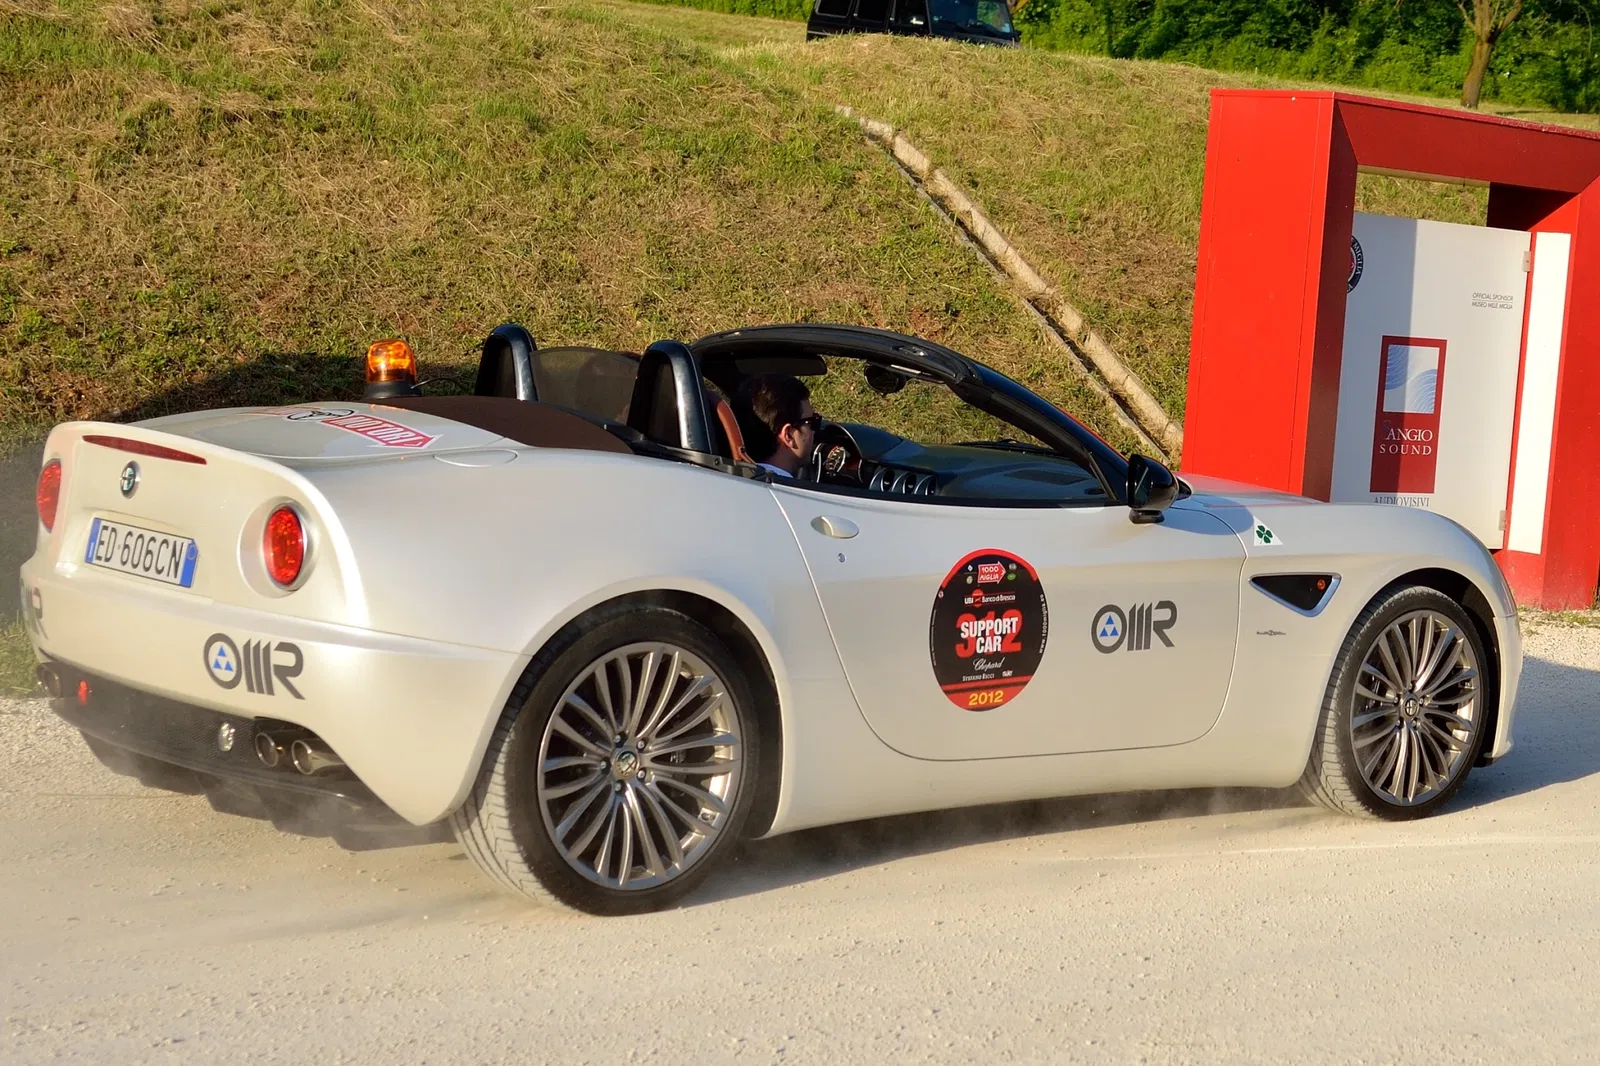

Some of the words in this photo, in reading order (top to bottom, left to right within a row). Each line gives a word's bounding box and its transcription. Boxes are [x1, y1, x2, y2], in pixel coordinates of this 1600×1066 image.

[1352, 242, 1363, 275] MIGLIA
[329, 416, 424, 444] MOTORI
[1379, 443, 1432, 456] SOUND
[1373, 496, 1430, 507] AUDIOVISIVI
[979, 573, 999, 581] MIGLIA
[981, 566, 999, 574] 1000
[964, 597, 974, 605] UBI
[960, 616, 1019, 639] SUPPORT
[975, 635, 1002, 654] CAR
[972, 656, 1006, 672] Chopard
[968, 690, 1004, 706] 2012
